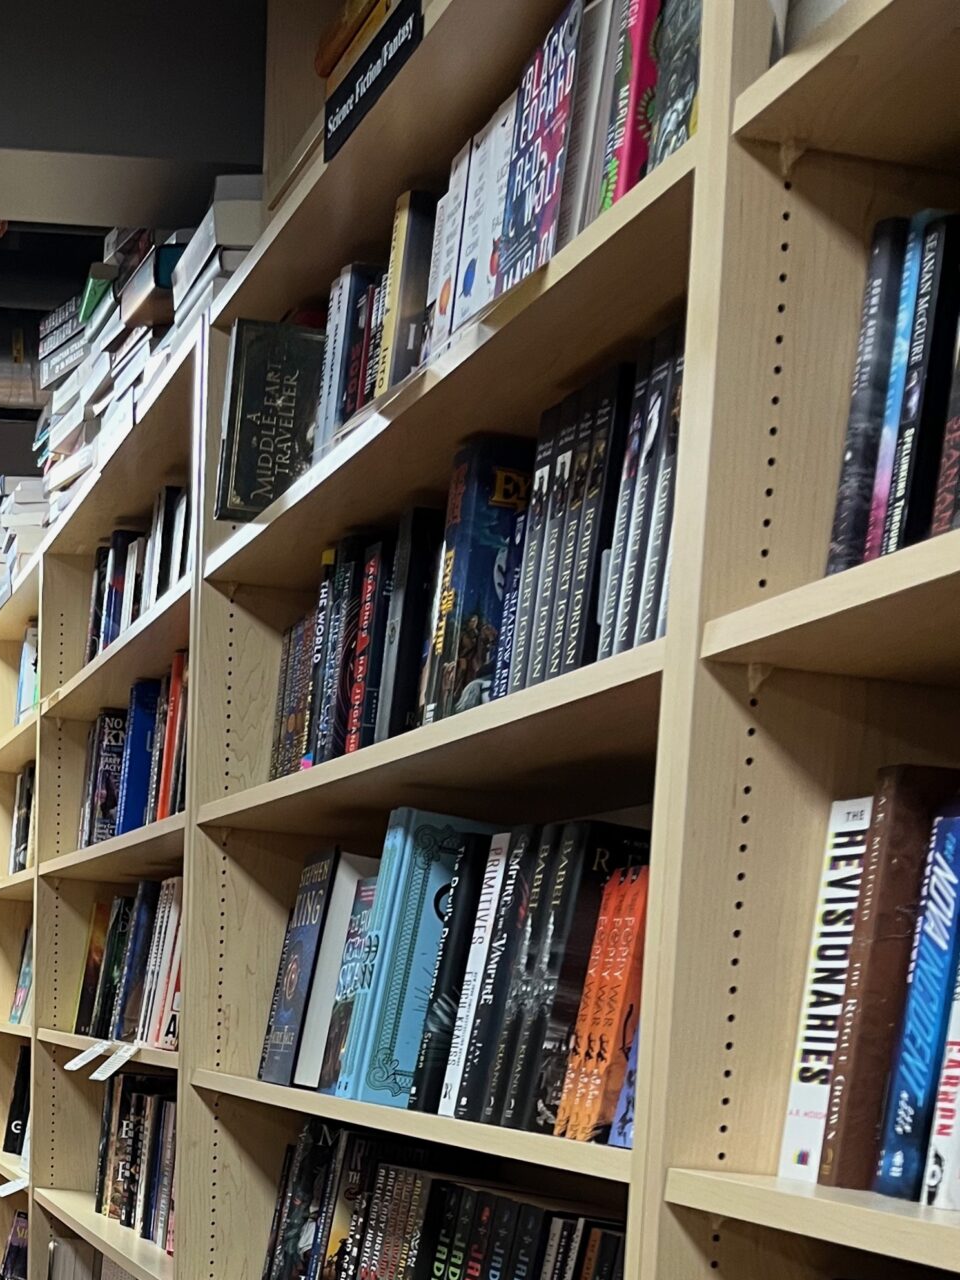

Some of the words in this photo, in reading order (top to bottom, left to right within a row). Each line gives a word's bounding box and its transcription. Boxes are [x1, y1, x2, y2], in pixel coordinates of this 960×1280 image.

[522, 17, 569, 105] BLACK
[328, 94, 354, 138] Science
[511, 49, 576, 161] LEOPARD
[918, 232, 939, 297] SEANAN
[910, 298, 930, 364] McGUIRE
[275, 369, 300, 476] TRAVELLER
[521, 540, 537, 608] ROBERT
[542, 527, 559, 599] ROBERT
[314, 608, 326, 664] WORLD
[512, 615, 527, 686] JORDAN
[532, 605, 548, 678] JORDAN
[846, 809, 865, 822] THE
[299, 859, 331, 888] STEPHEN
[453, 845, 465, 872] The
[528, 844, 550, 909] BABEL
[551, 840, 574, 907] BABEL
[471, 847, 503, 946] PRIMITIVES
[924, 852, 960, 953] NOVA
[798, 829, 867, 1087] REVISIONARIES
[900, 937, 949, 1107] INCIDENT
